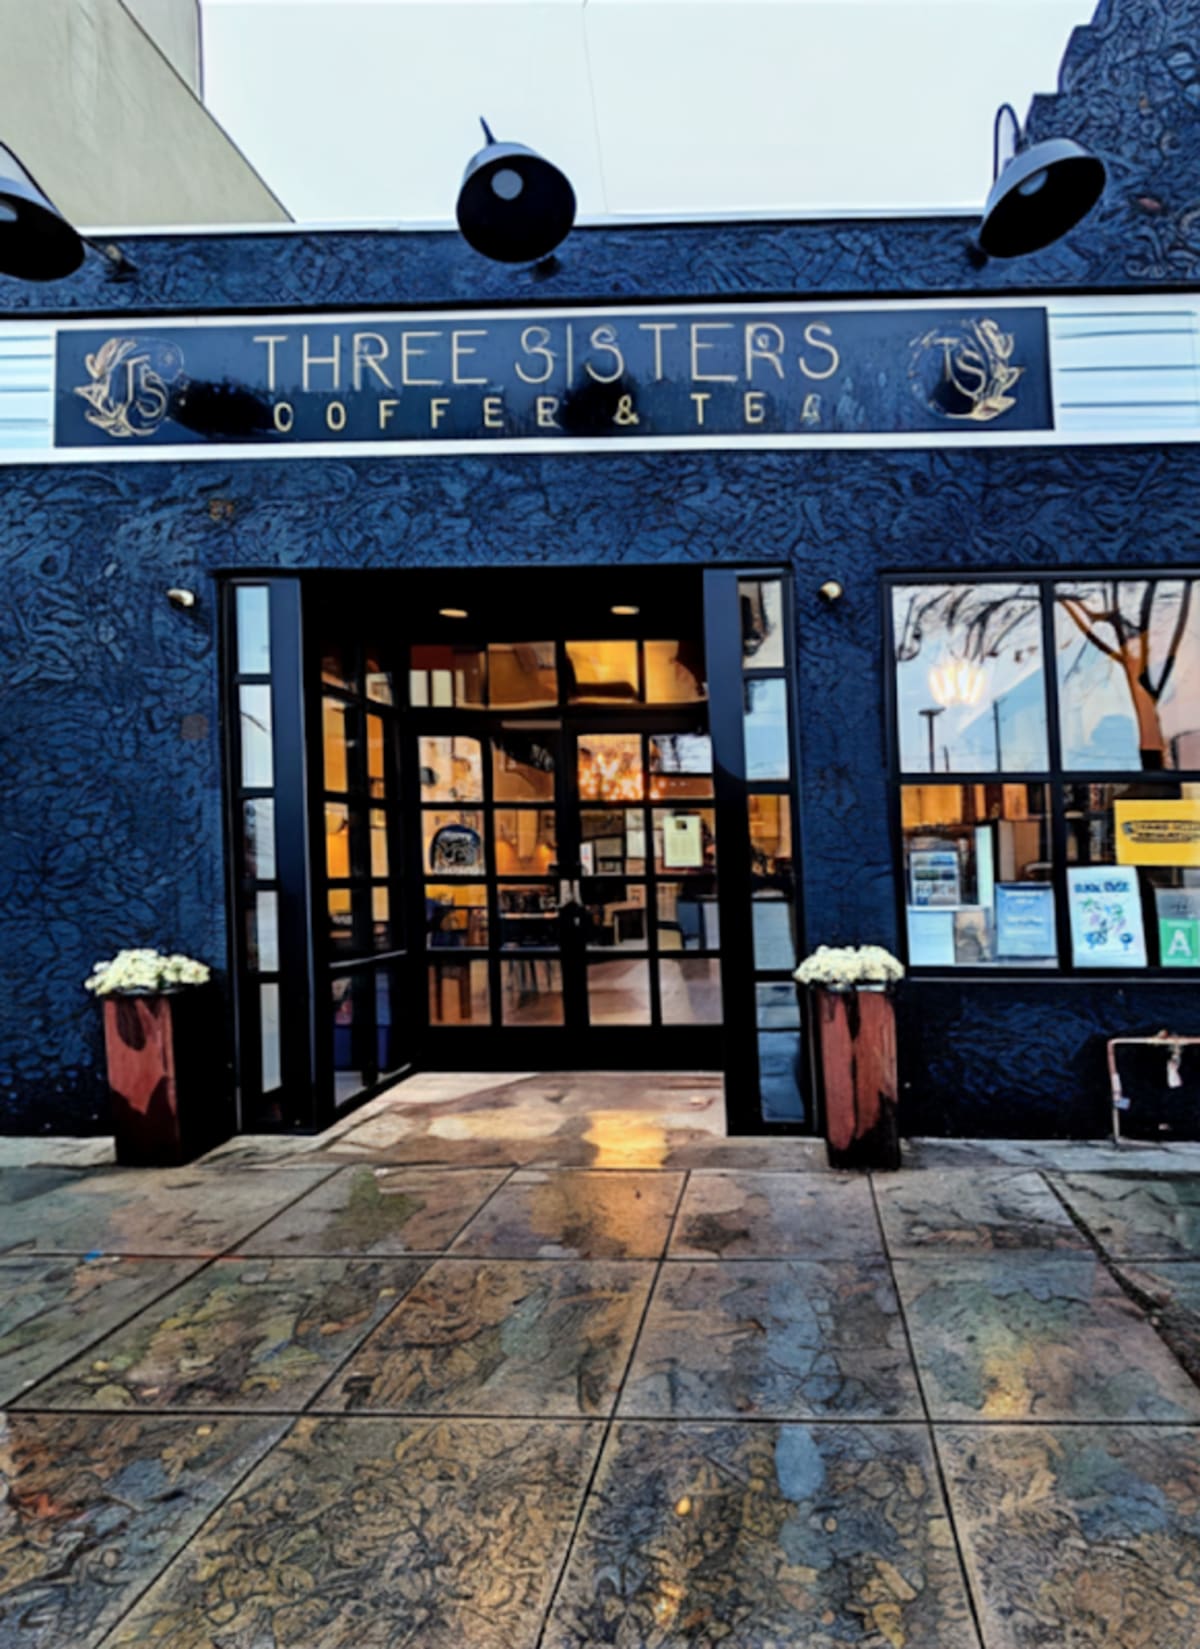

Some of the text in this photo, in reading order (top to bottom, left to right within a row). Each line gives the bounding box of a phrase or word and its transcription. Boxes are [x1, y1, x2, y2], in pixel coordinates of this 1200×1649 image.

[252, 321, 840, 392] THREE SISTERS
[613, 394, 640, 425] &
[1167, 929, 1193, 957] A
